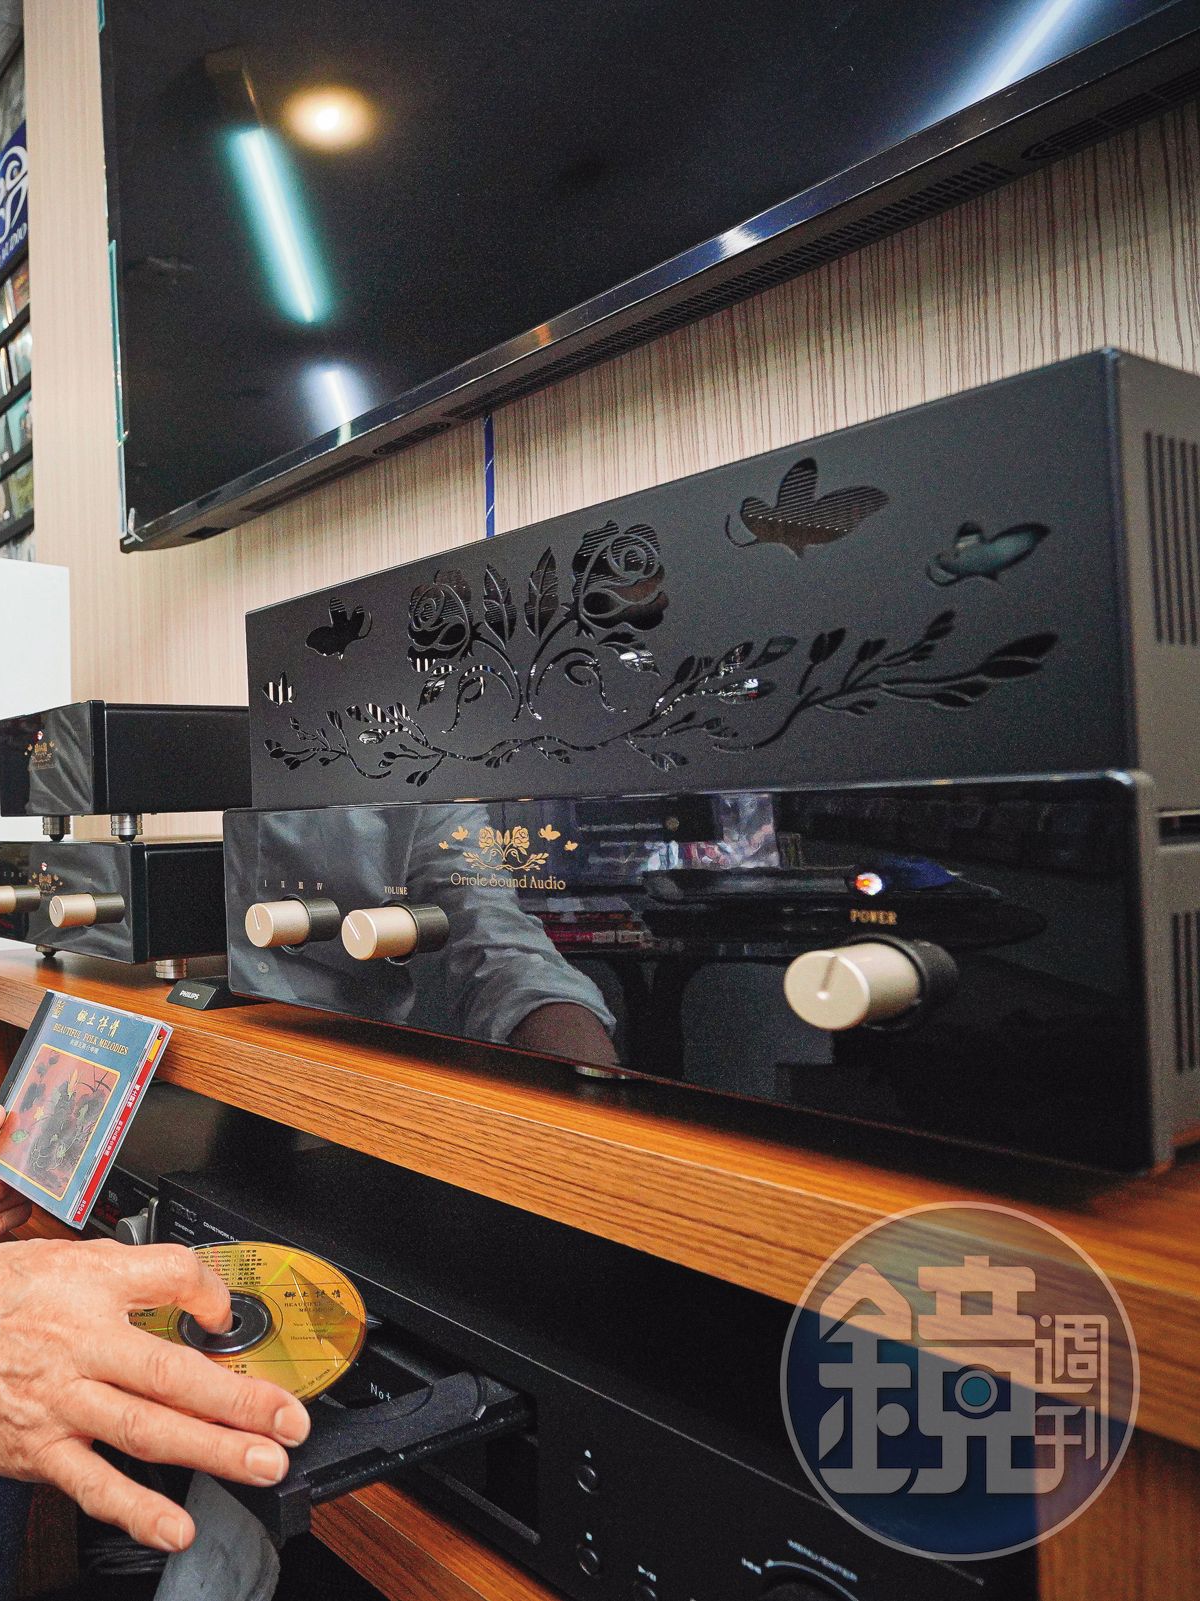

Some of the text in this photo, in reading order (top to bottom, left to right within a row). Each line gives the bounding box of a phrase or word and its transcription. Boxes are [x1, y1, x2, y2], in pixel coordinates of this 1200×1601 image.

[450, 872, 567, 890] Oriole Sound Audio
[384, 885, 408, 895] VOLUME
[850, 908, 898, 926] POWER
[179, 989, 200, 1001] PHILIPS
